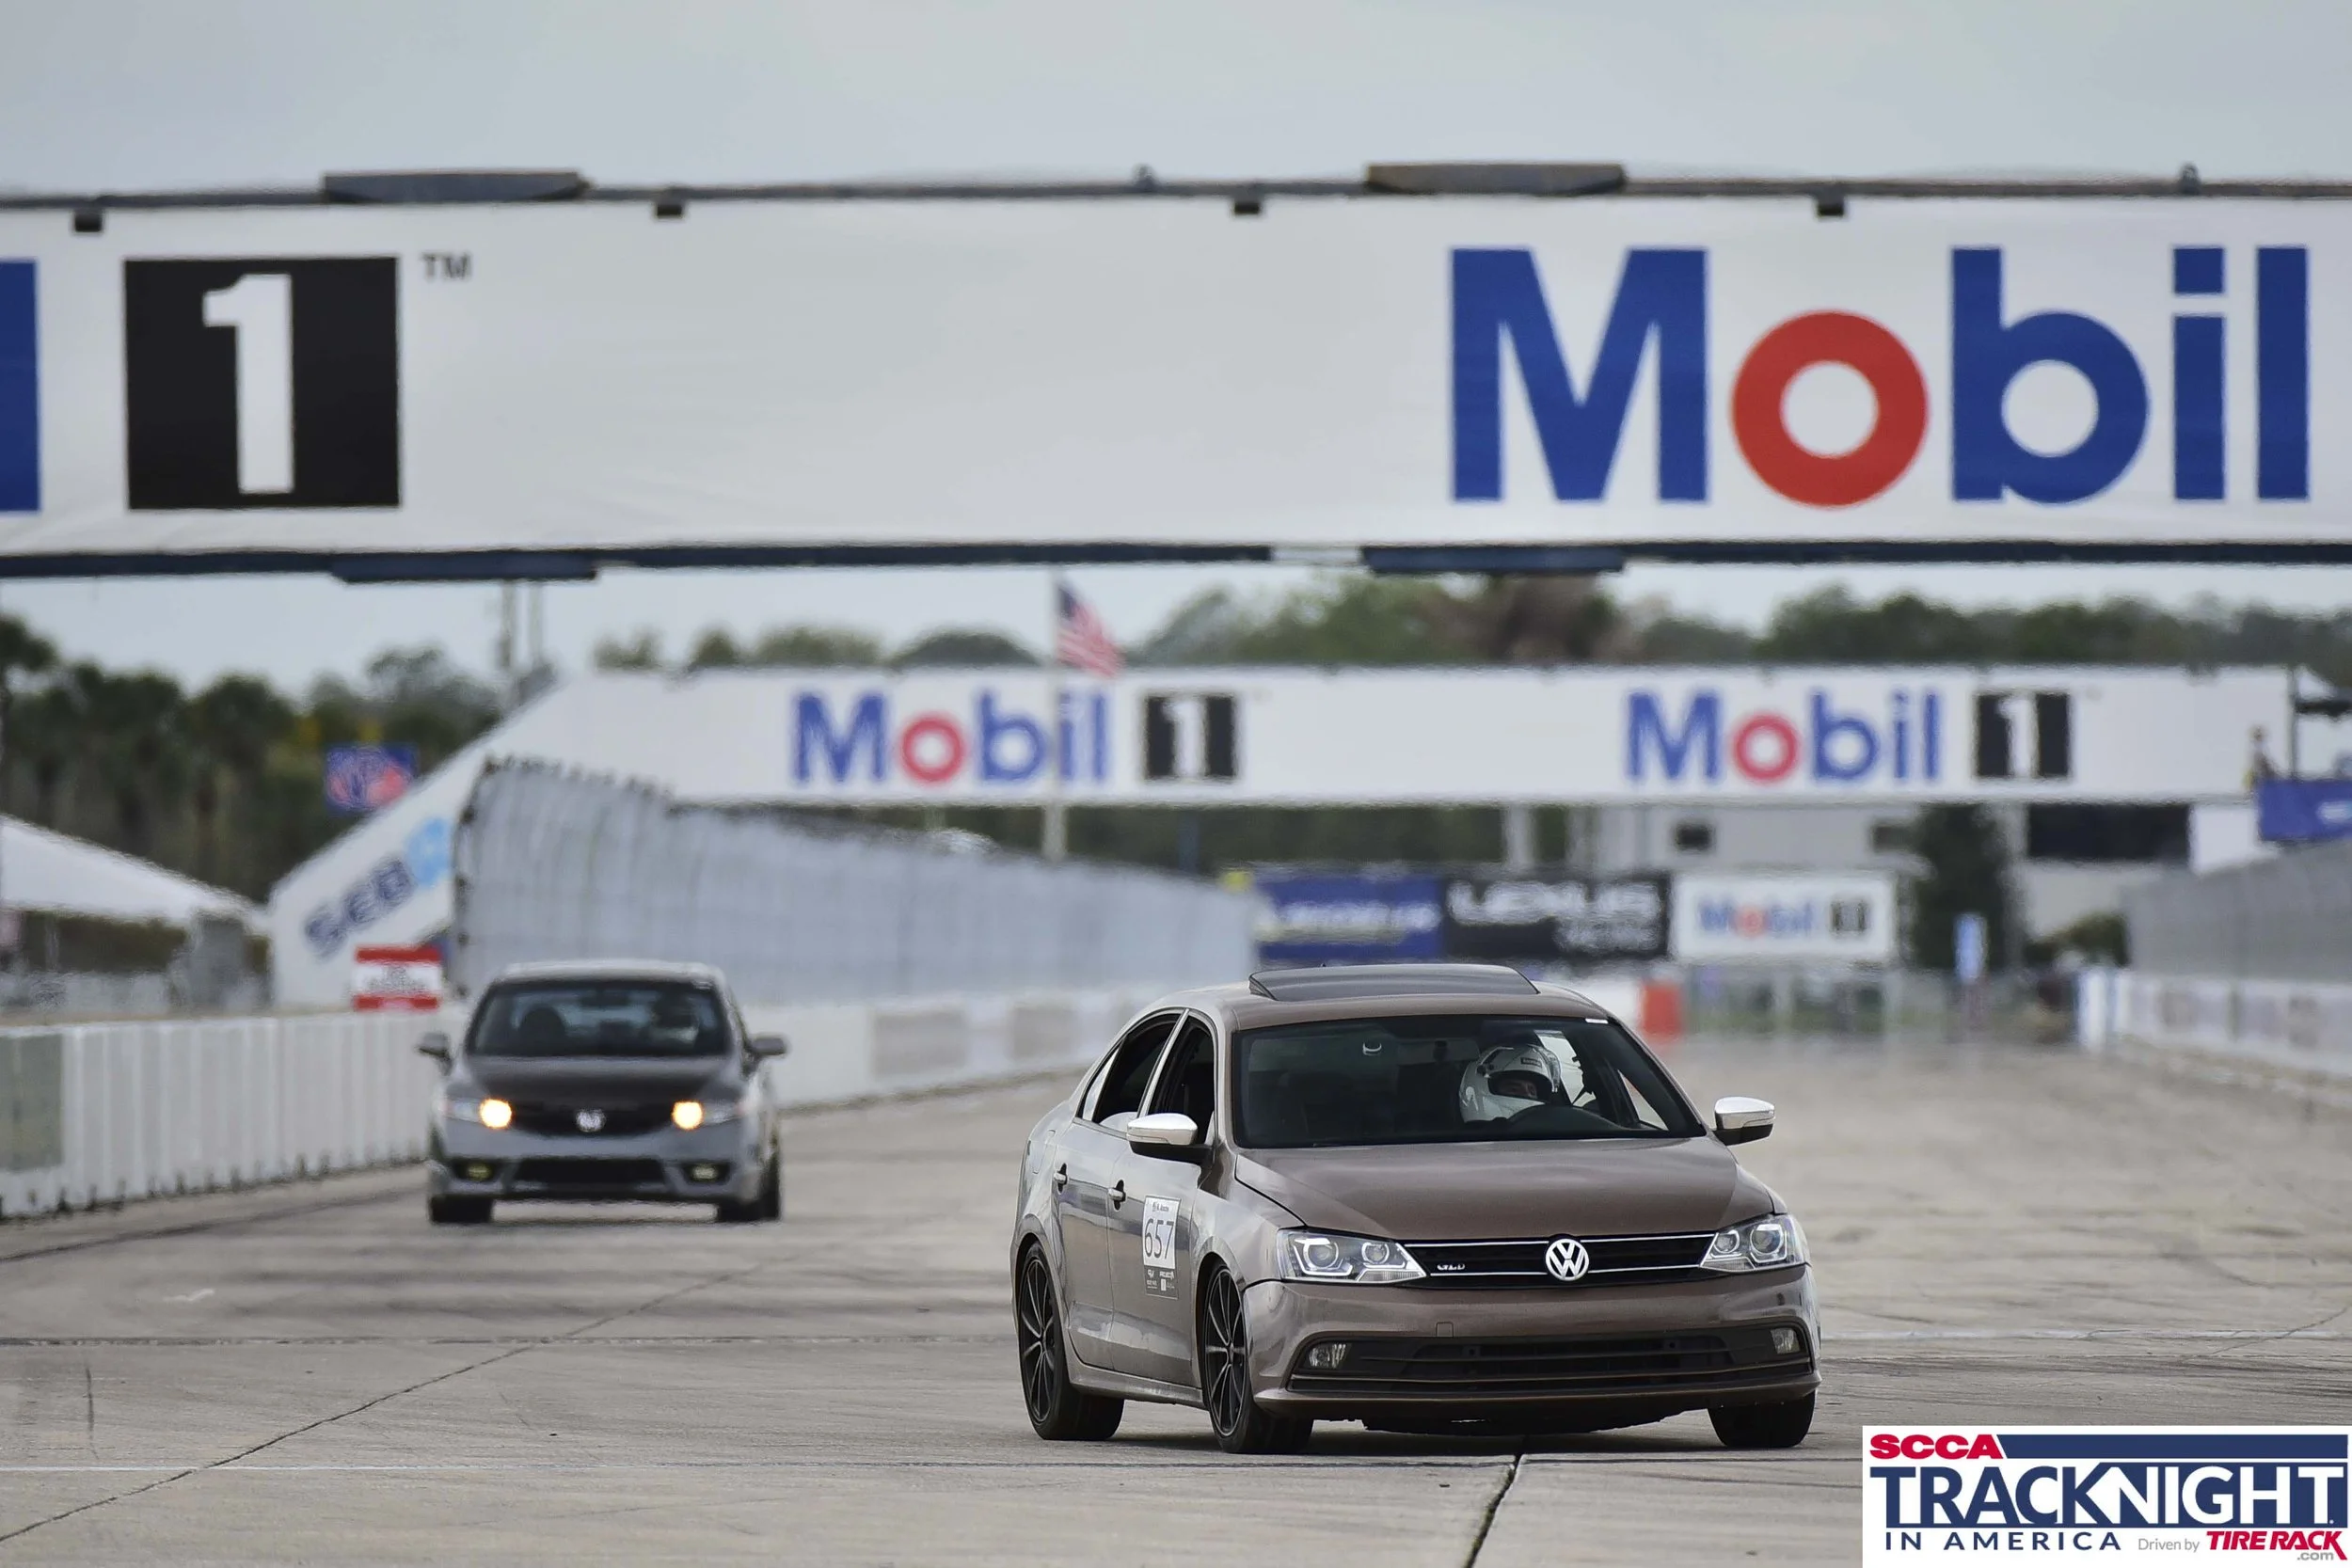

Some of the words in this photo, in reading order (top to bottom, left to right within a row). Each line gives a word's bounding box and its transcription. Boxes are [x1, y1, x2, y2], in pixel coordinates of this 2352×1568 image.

[201, 273, 294, 495] 1
[421, 252, 470, 279] TM
[1450, 246, 2310, 508] Mobil
[792, 691, 1108, 786] Mobil
[1161, 697, 1208, 779] 1
[1627, 690, 1939, 784] Mobil
[1994, 696, 2040, 779] 1
[1144, 1217, 1175, 1259] 657
[1547, 1240, 1588, 1280] VW
